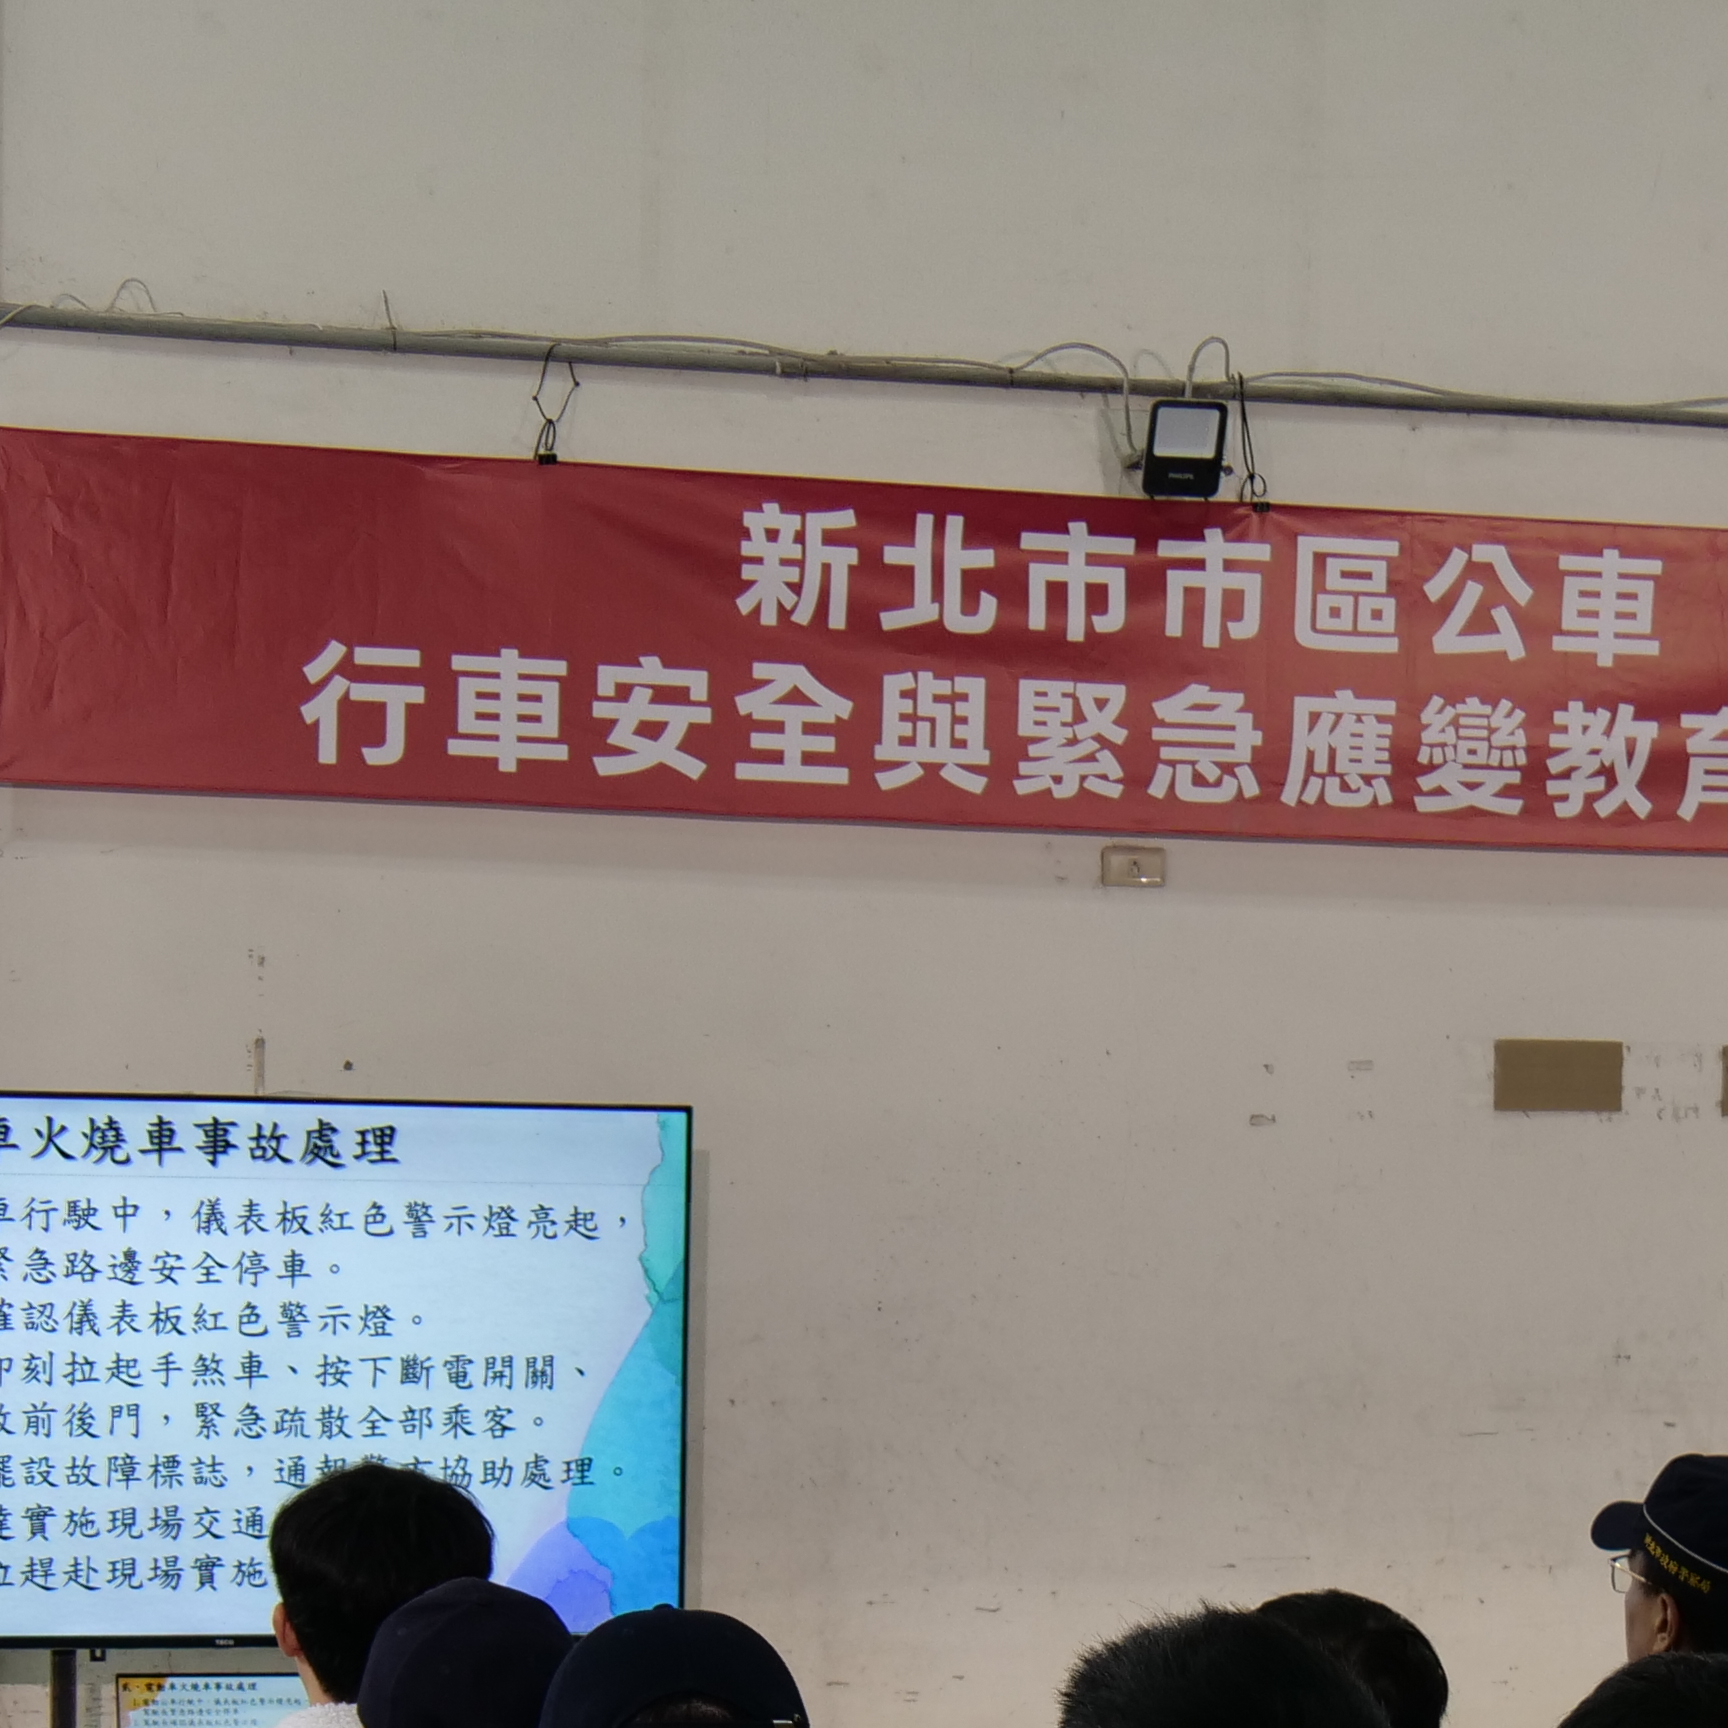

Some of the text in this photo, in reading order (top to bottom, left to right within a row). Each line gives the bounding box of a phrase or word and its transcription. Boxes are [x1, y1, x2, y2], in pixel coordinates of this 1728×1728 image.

[736, 501, 1663, 668] 新北市市區公車
